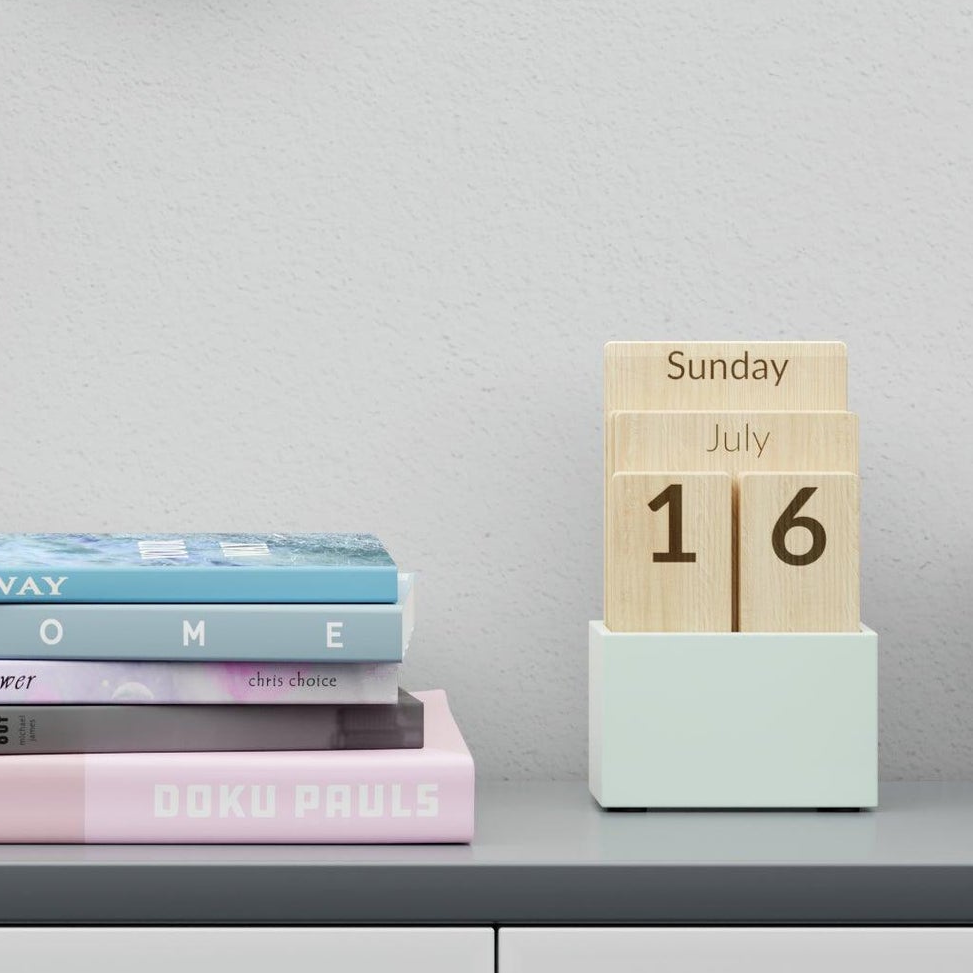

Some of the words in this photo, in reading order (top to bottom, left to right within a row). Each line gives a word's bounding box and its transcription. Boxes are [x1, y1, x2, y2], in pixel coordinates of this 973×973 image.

[668, 351, 789, 387] Sunday
[707, 423, 771, 458] July
[248, 671, 284, 687] chris
[289, 671, 338, 687] choice
[154, 783, 276, 818] DOKU
[295, 783, 440, 818] PAULS
